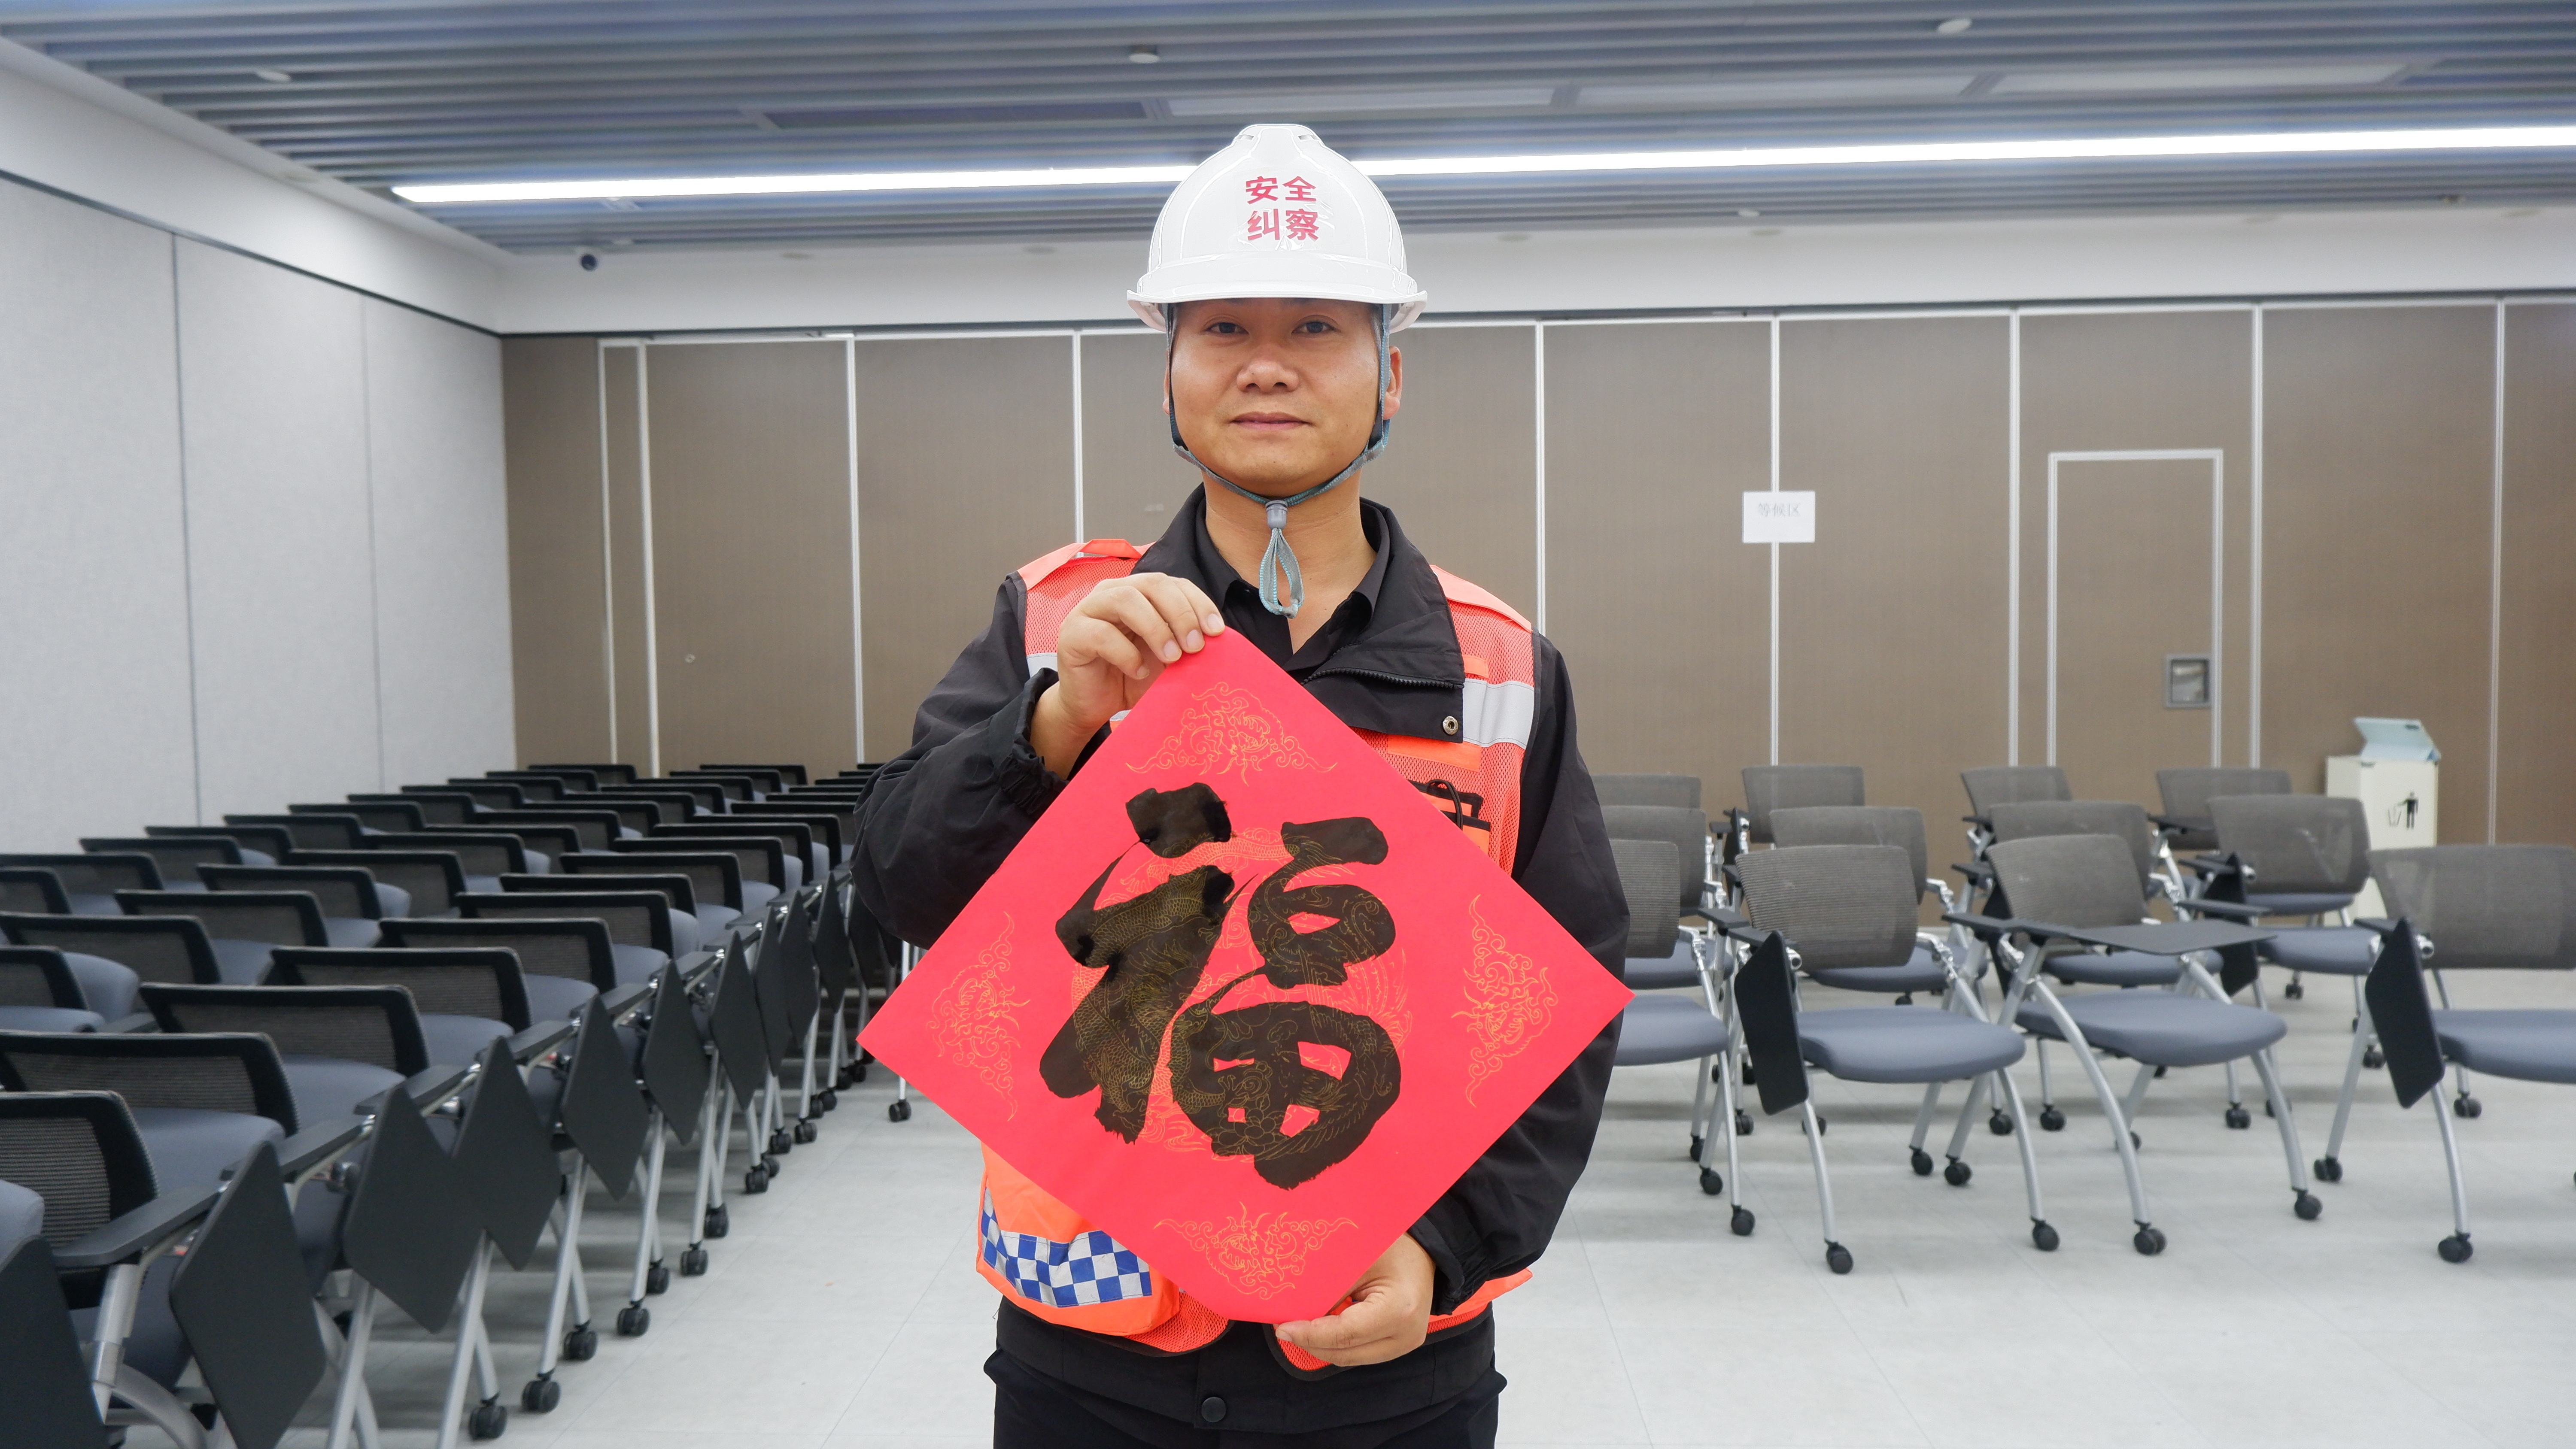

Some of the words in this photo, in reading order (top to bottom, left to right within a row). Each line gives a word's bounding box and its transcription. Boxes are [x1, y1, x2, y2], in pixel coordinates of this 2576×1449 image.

[1245, 176, 1317, 205] 安全
[1247, 209, 1319, 241] 纠察
[1039, 782, 1401, 1189] 福
